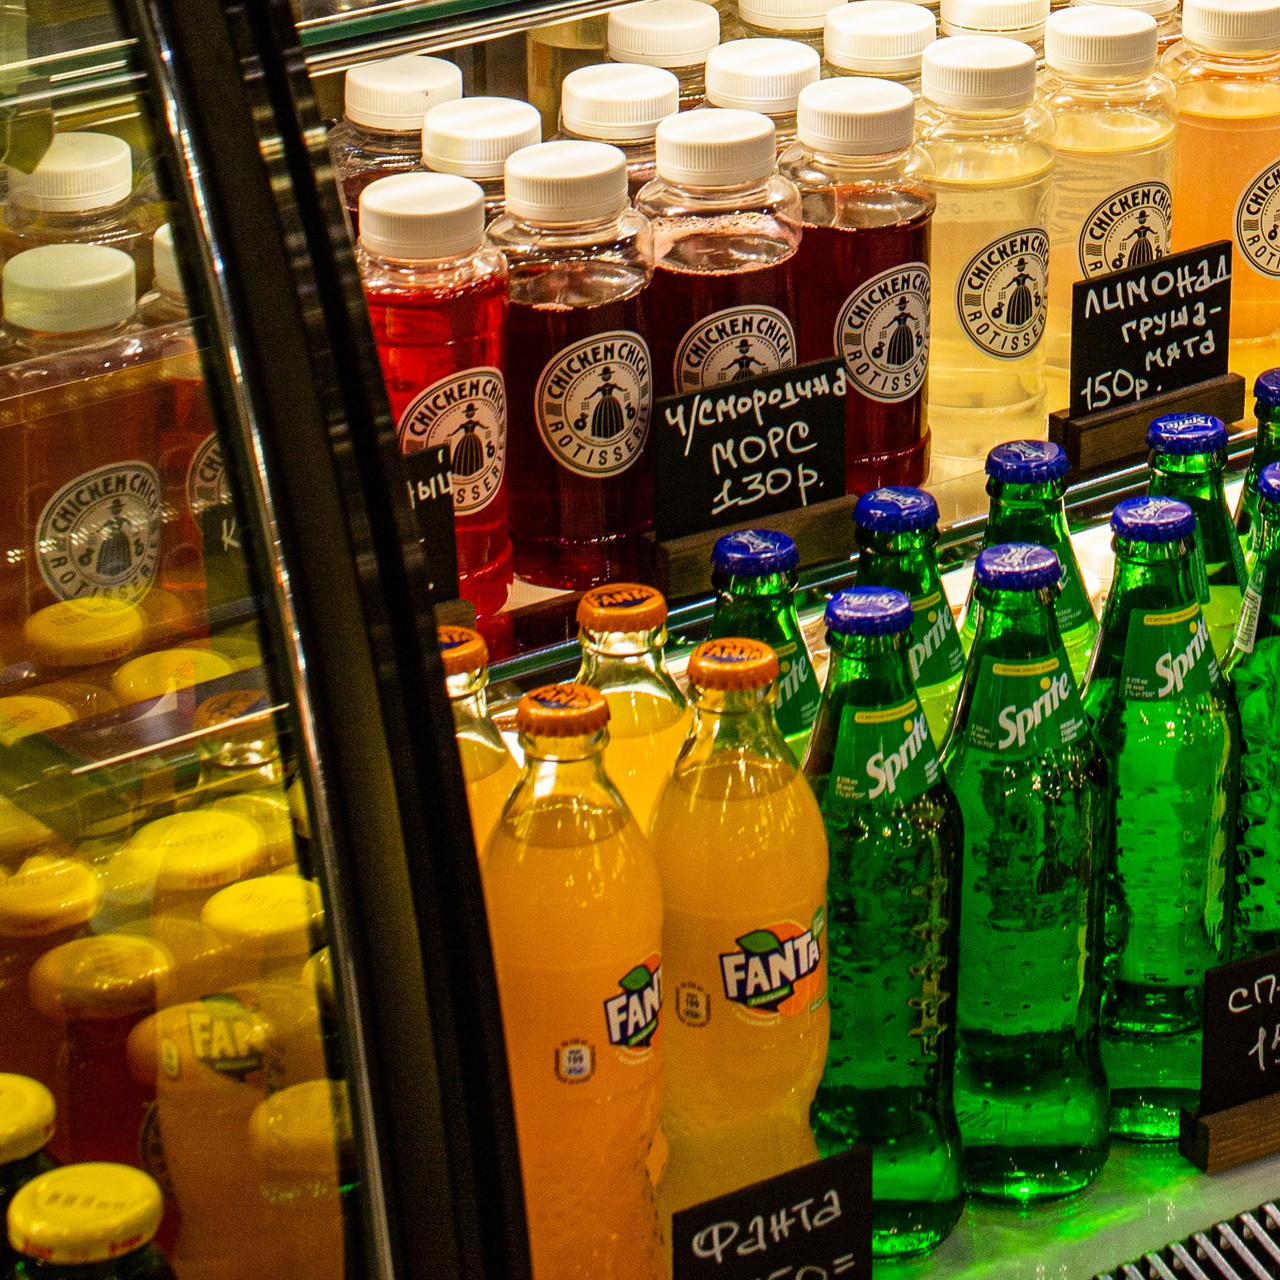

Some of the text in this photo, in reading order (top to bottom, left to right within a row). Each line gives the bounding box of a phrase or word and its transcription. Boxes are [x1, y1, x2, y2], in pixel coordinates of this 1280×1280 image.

[1089, 189, 1150, 241] CHICKEN
[967, 236, 1029, 290] CHICKEN
[848, 274, 911, 330] CHICKEN
[686, 317, 790, 367] CHICKEN CHICK
[547, 343, 648, 399] CHICKEN CHICK
[409, 379, 480, 436] CHICKEN
[550, 404, 648, 467] ROTISSERIE
[908, 603, 952, 682] prite
[998, 671, 1070, 750] Sprite
[866, 711, 928, 800] Sprite
[721, 930, 820, 999] FANTA
